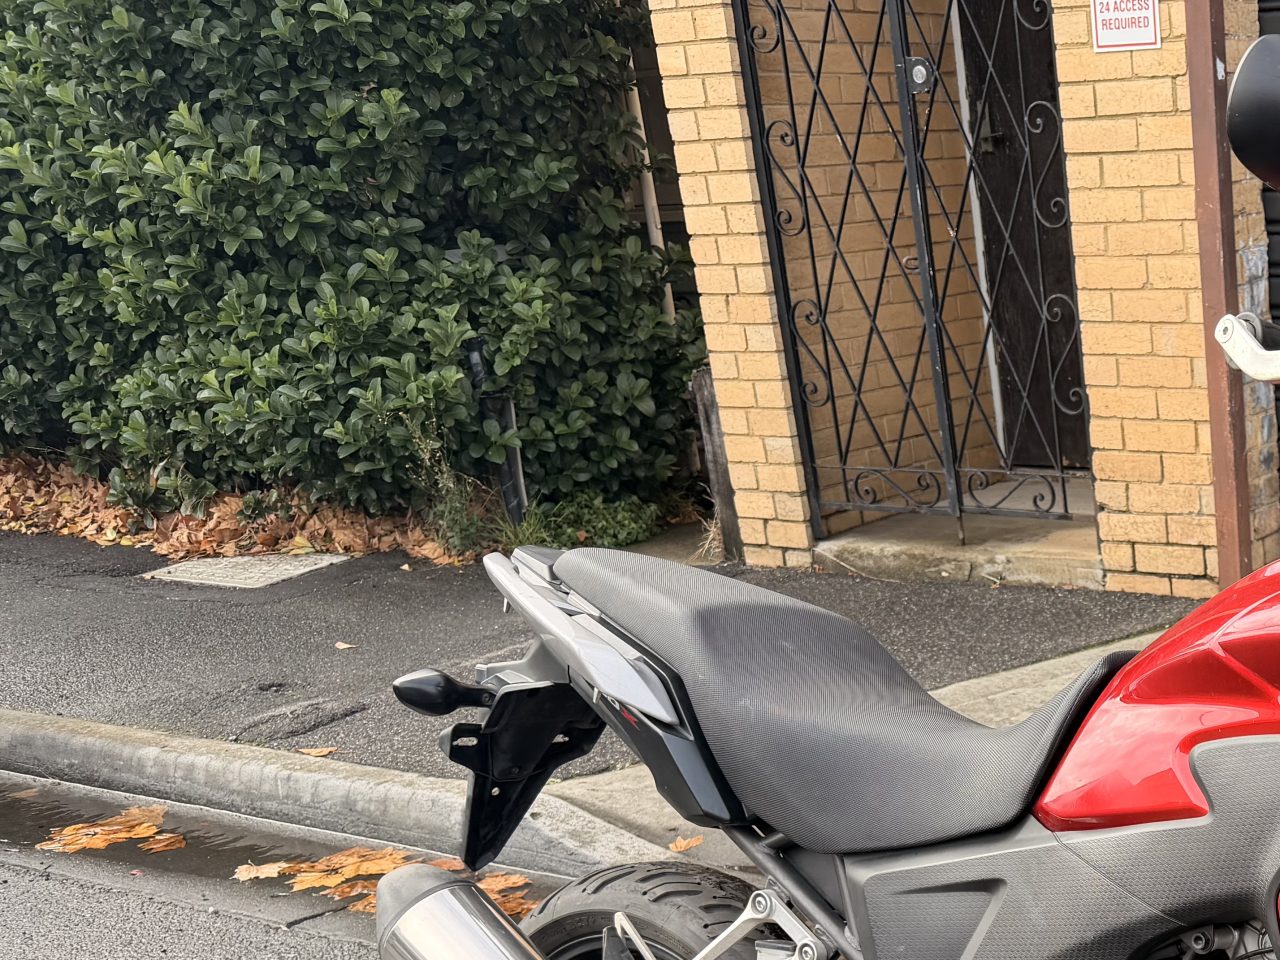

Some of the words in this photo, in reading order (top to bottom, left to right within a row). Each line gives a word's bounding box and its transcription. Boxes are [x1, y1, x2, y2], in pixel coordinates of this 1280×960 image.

[1099, 2, 1110, 14] 24
[1113, 0, 1150, 13] ACCESS
[1101, 16, 1150, 31] REQUIRED
